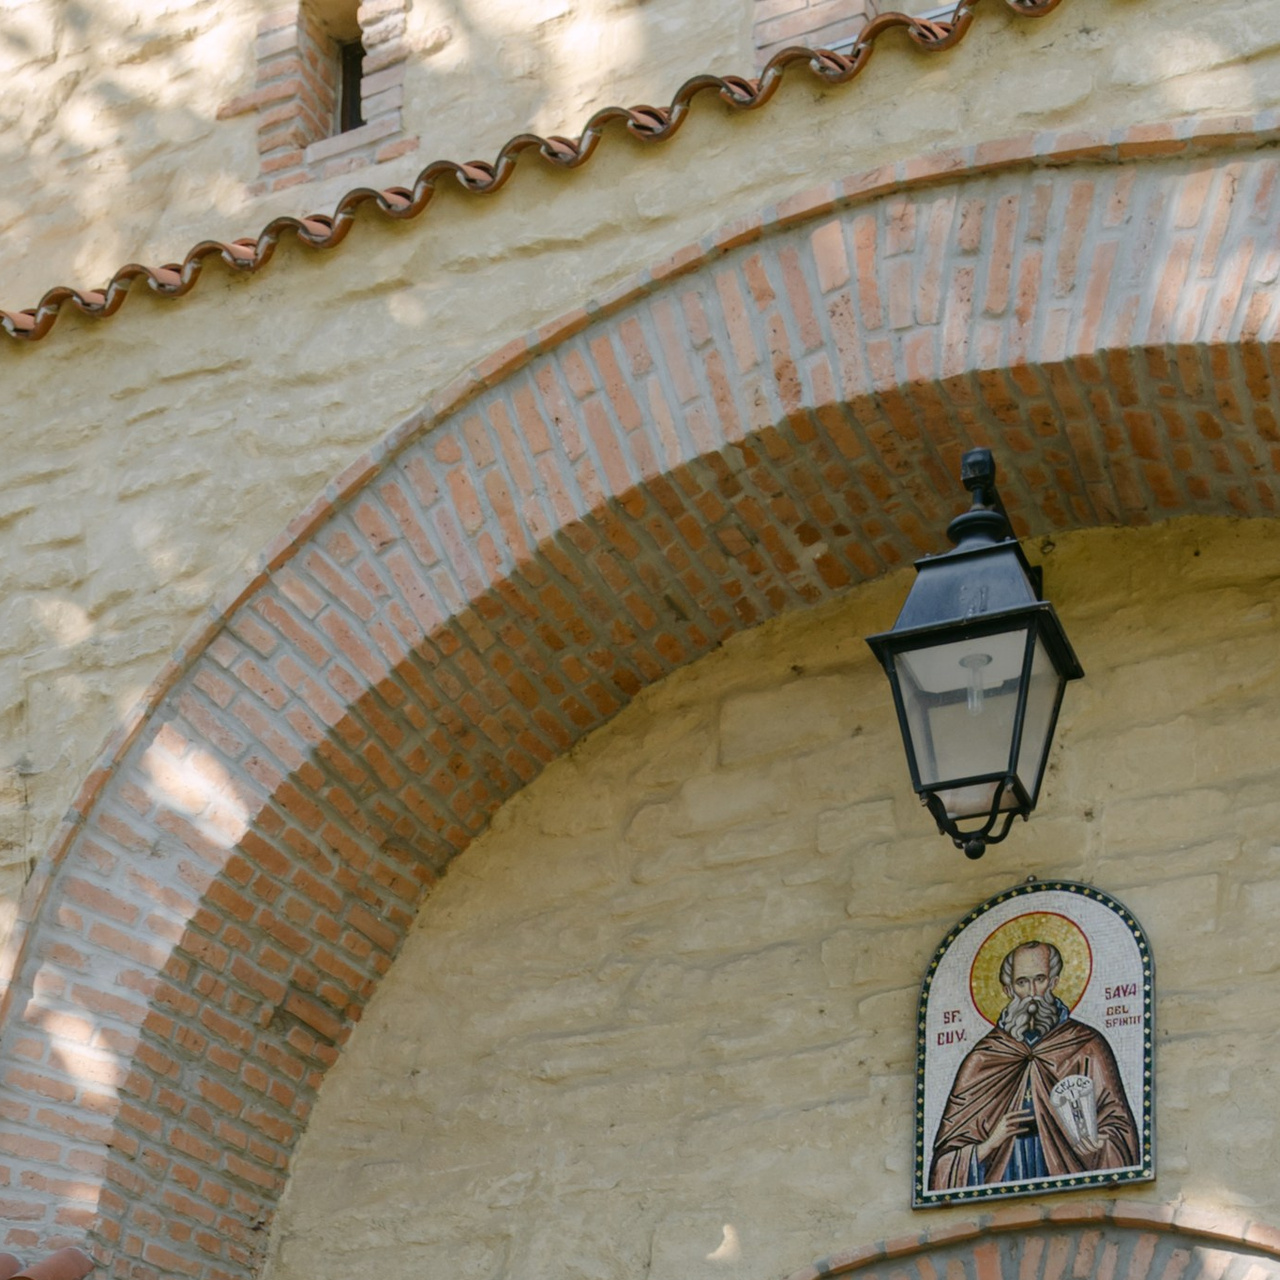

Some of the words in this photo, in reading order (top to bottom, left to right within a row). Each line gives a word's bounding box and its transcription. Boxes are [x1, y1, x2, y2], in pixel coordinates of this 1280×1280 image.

[1105, 983, 1137, 1000] SAVA
[943, 1010, 962, 1025] SF.
[1106, 1005, 1129, 1016] CEL
[937, 1029, 967, 1046] CUV.
